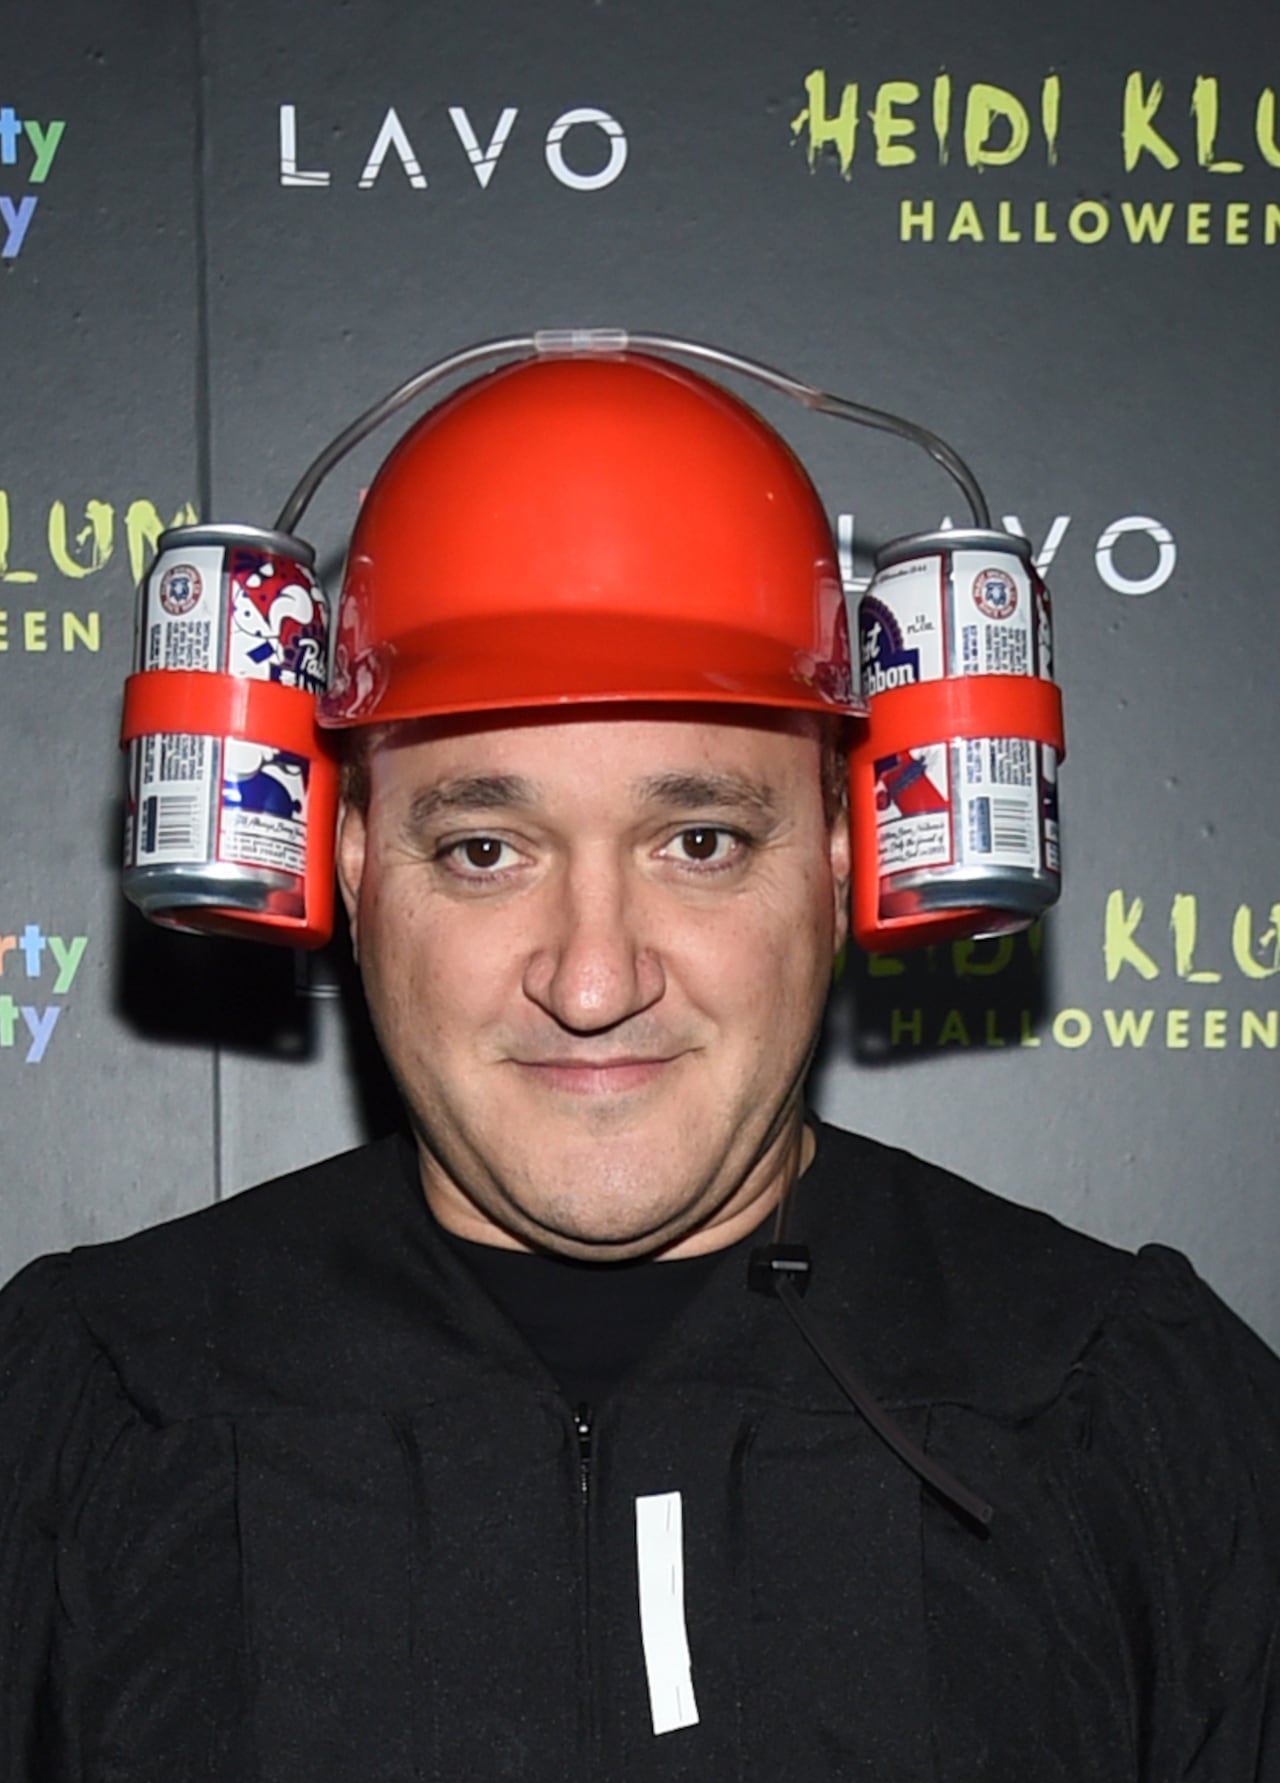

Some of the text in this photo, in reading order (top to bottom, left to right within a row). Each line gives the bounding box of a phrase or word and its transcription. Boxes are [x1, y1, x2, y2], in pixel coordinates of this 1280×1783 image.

[280, 105, 627, 190] LAVO
[791, 70, 1059, 180] HEIDI
[837, 515, 1176, 594] LVO
[889, 1005, 1277, 1048] HALLOWEEN
[635, 1491, 699, 1735] I
